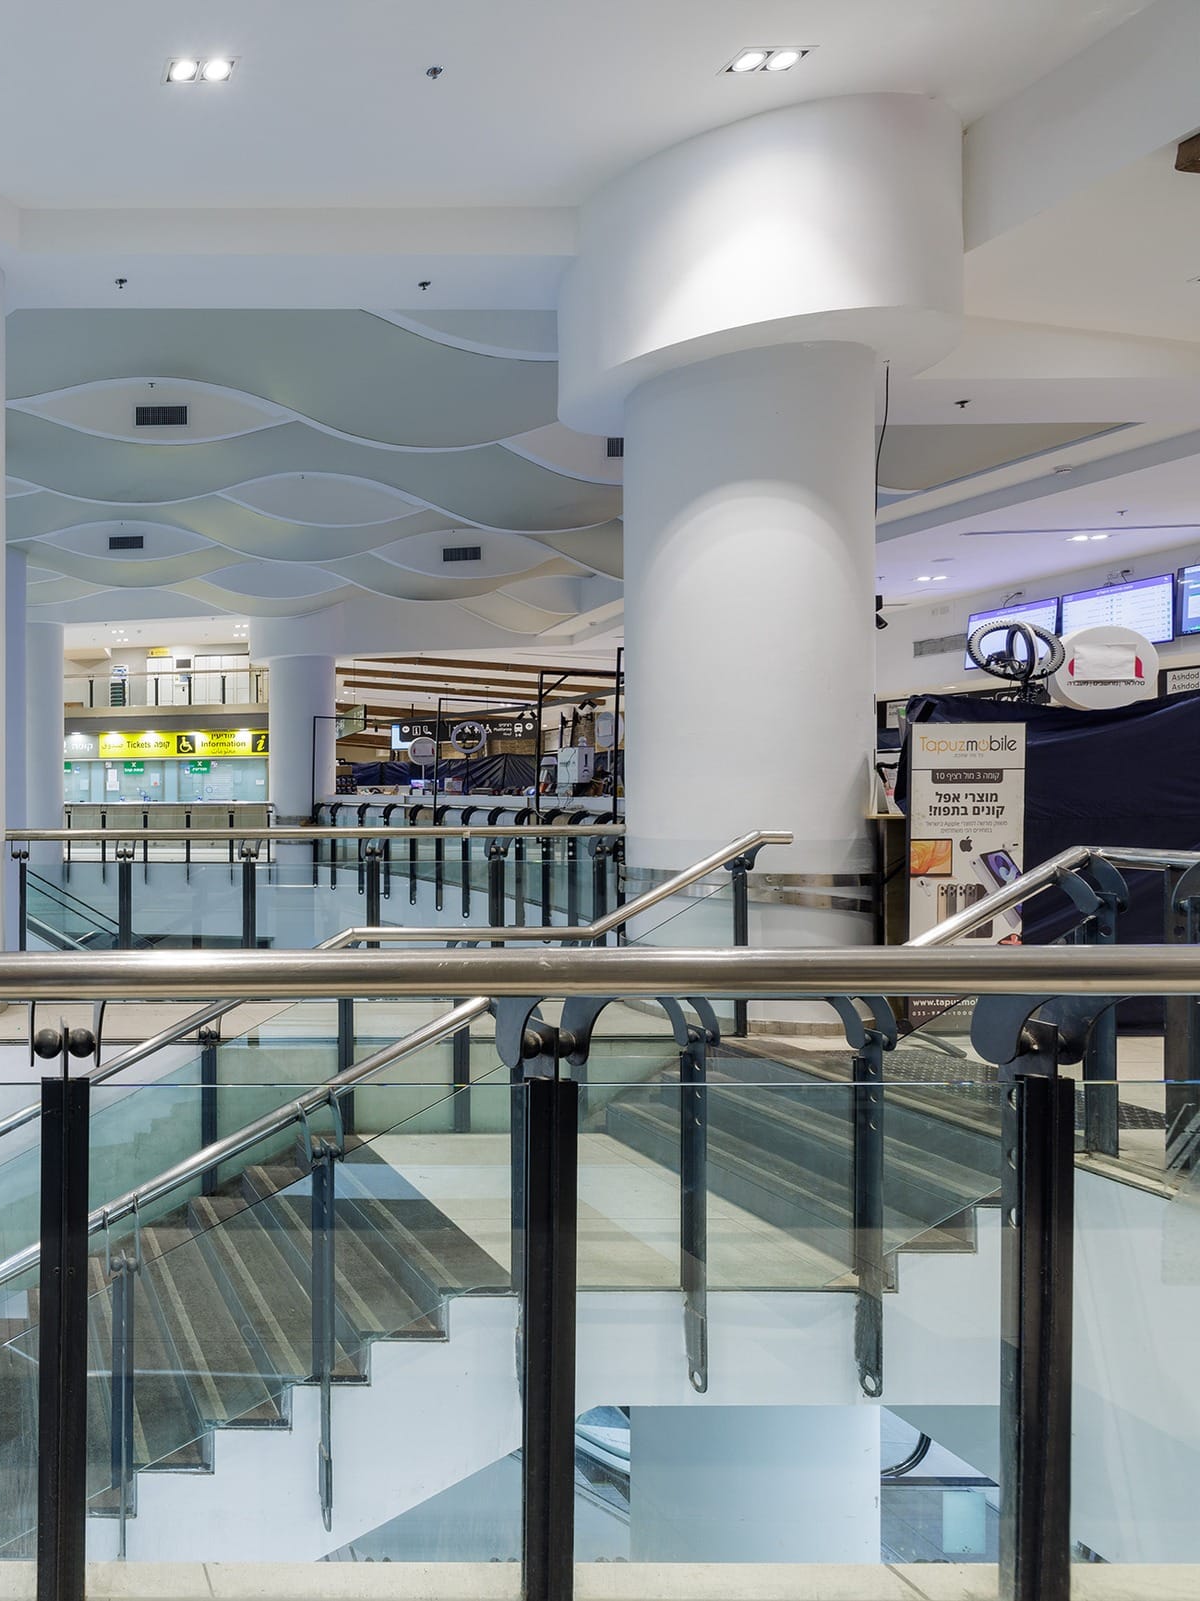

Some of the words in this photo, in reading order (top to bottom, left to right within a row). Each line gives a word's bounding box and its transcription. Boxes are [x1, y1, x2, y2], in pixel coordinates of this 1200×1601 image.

[1171, 671, 1200, 682] Ashdod
[1171, 681, 1200, 691] Ashdod
[126, 741, 151, 749] Tickets
[201, 740, 246, 748] Information
[919, 734, 1017, 755] Tapuzmobile
[935, 772, 945, 780] 10
[945, 772, 962, 781] רציף
[963, 771, 975, 780] מול
[976, 772, 981, 780] 3
[982, 771, 1000, 781] קומה
[935, 791, 961, 803] אפל
[965, 792, 999, 803] מוצרי
[928, 805, 969, 816] בתפוז!
[972, 805, 1005, 818] קונים
